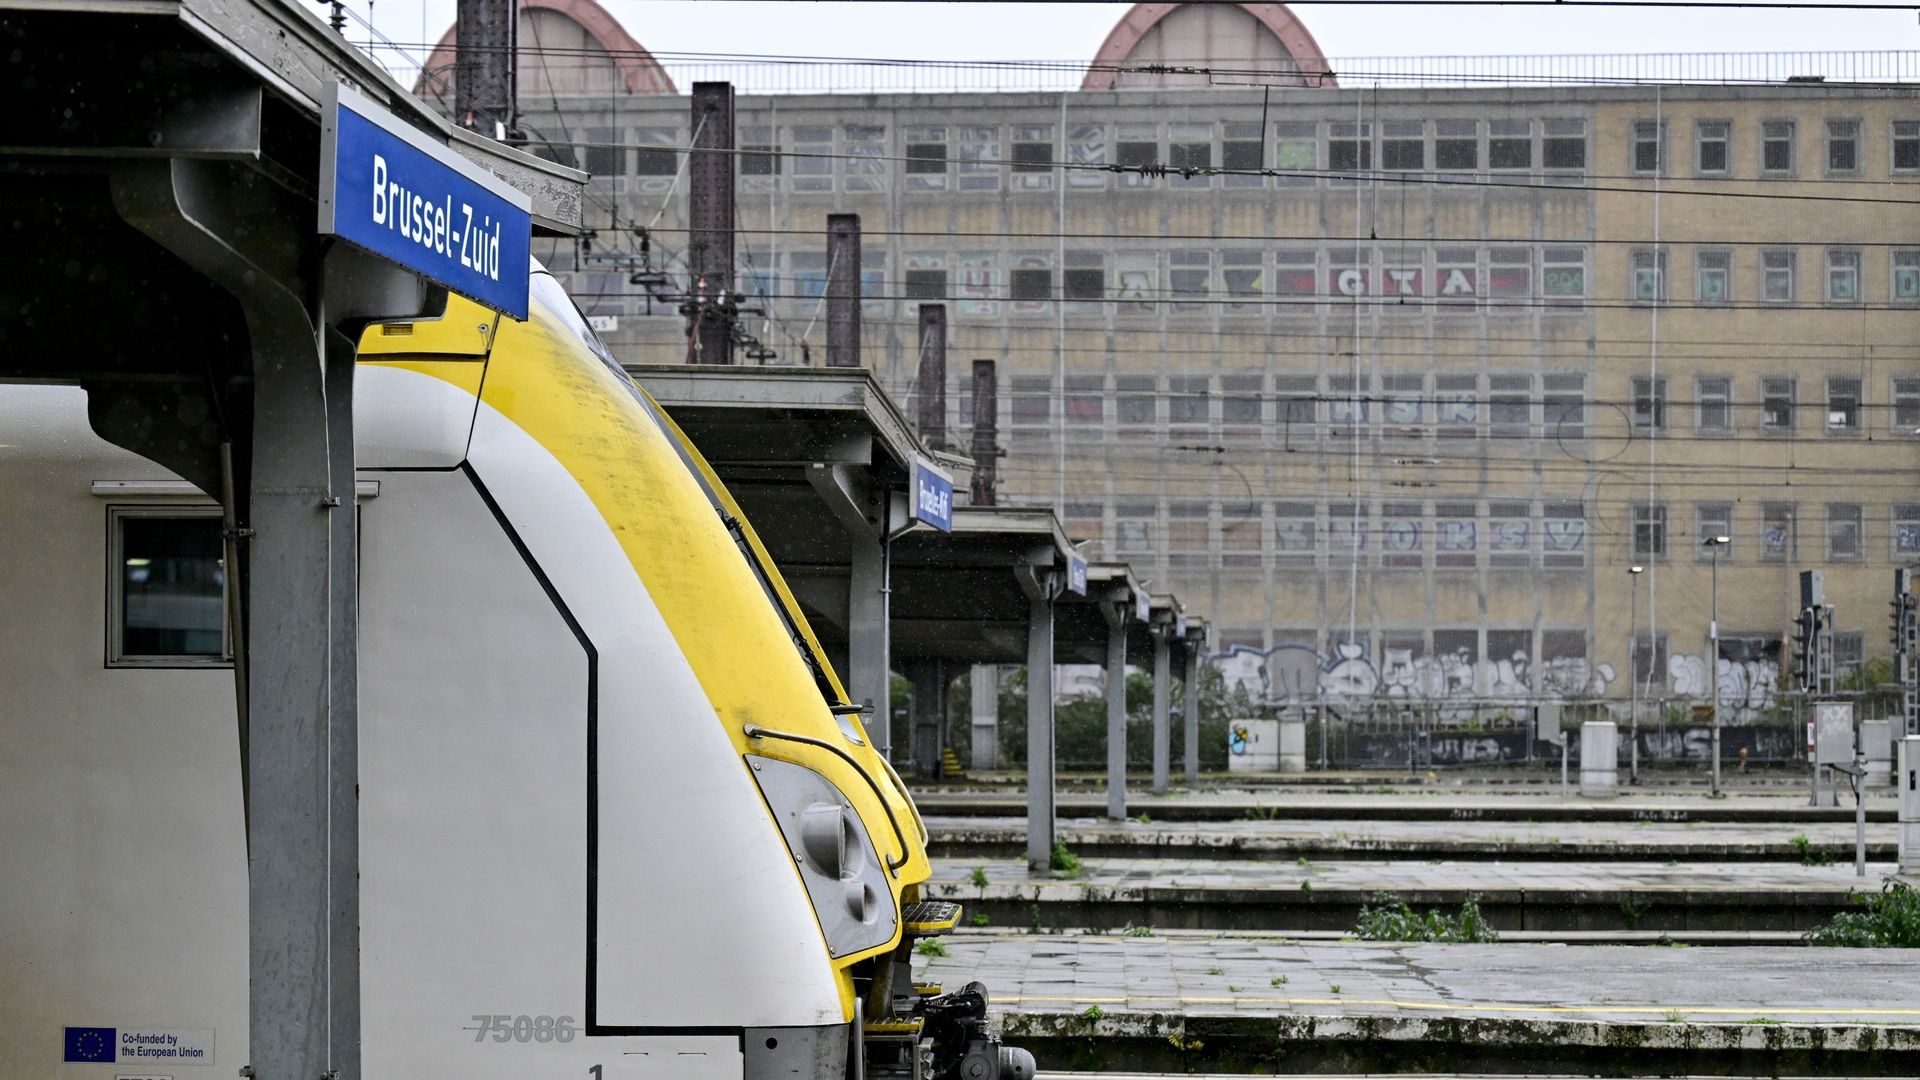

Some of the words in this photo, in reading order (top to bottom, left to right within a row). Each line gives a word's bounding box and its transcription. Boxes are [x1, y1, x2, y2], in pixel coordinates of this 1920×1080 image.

[373, 154, 500, 281] Brussel-Zuid
[1337, 269, 1475, 296] GTA
[122, 1033, 165, 1044] Co-funded
[167, 1034, 178, 1046] by
[471, 1014, 576, 1043] 75086
[122, 1046, 135, 1057] the
[137, 1046, 177, 1059] European
[179, 1047, 203, 1058] Union
